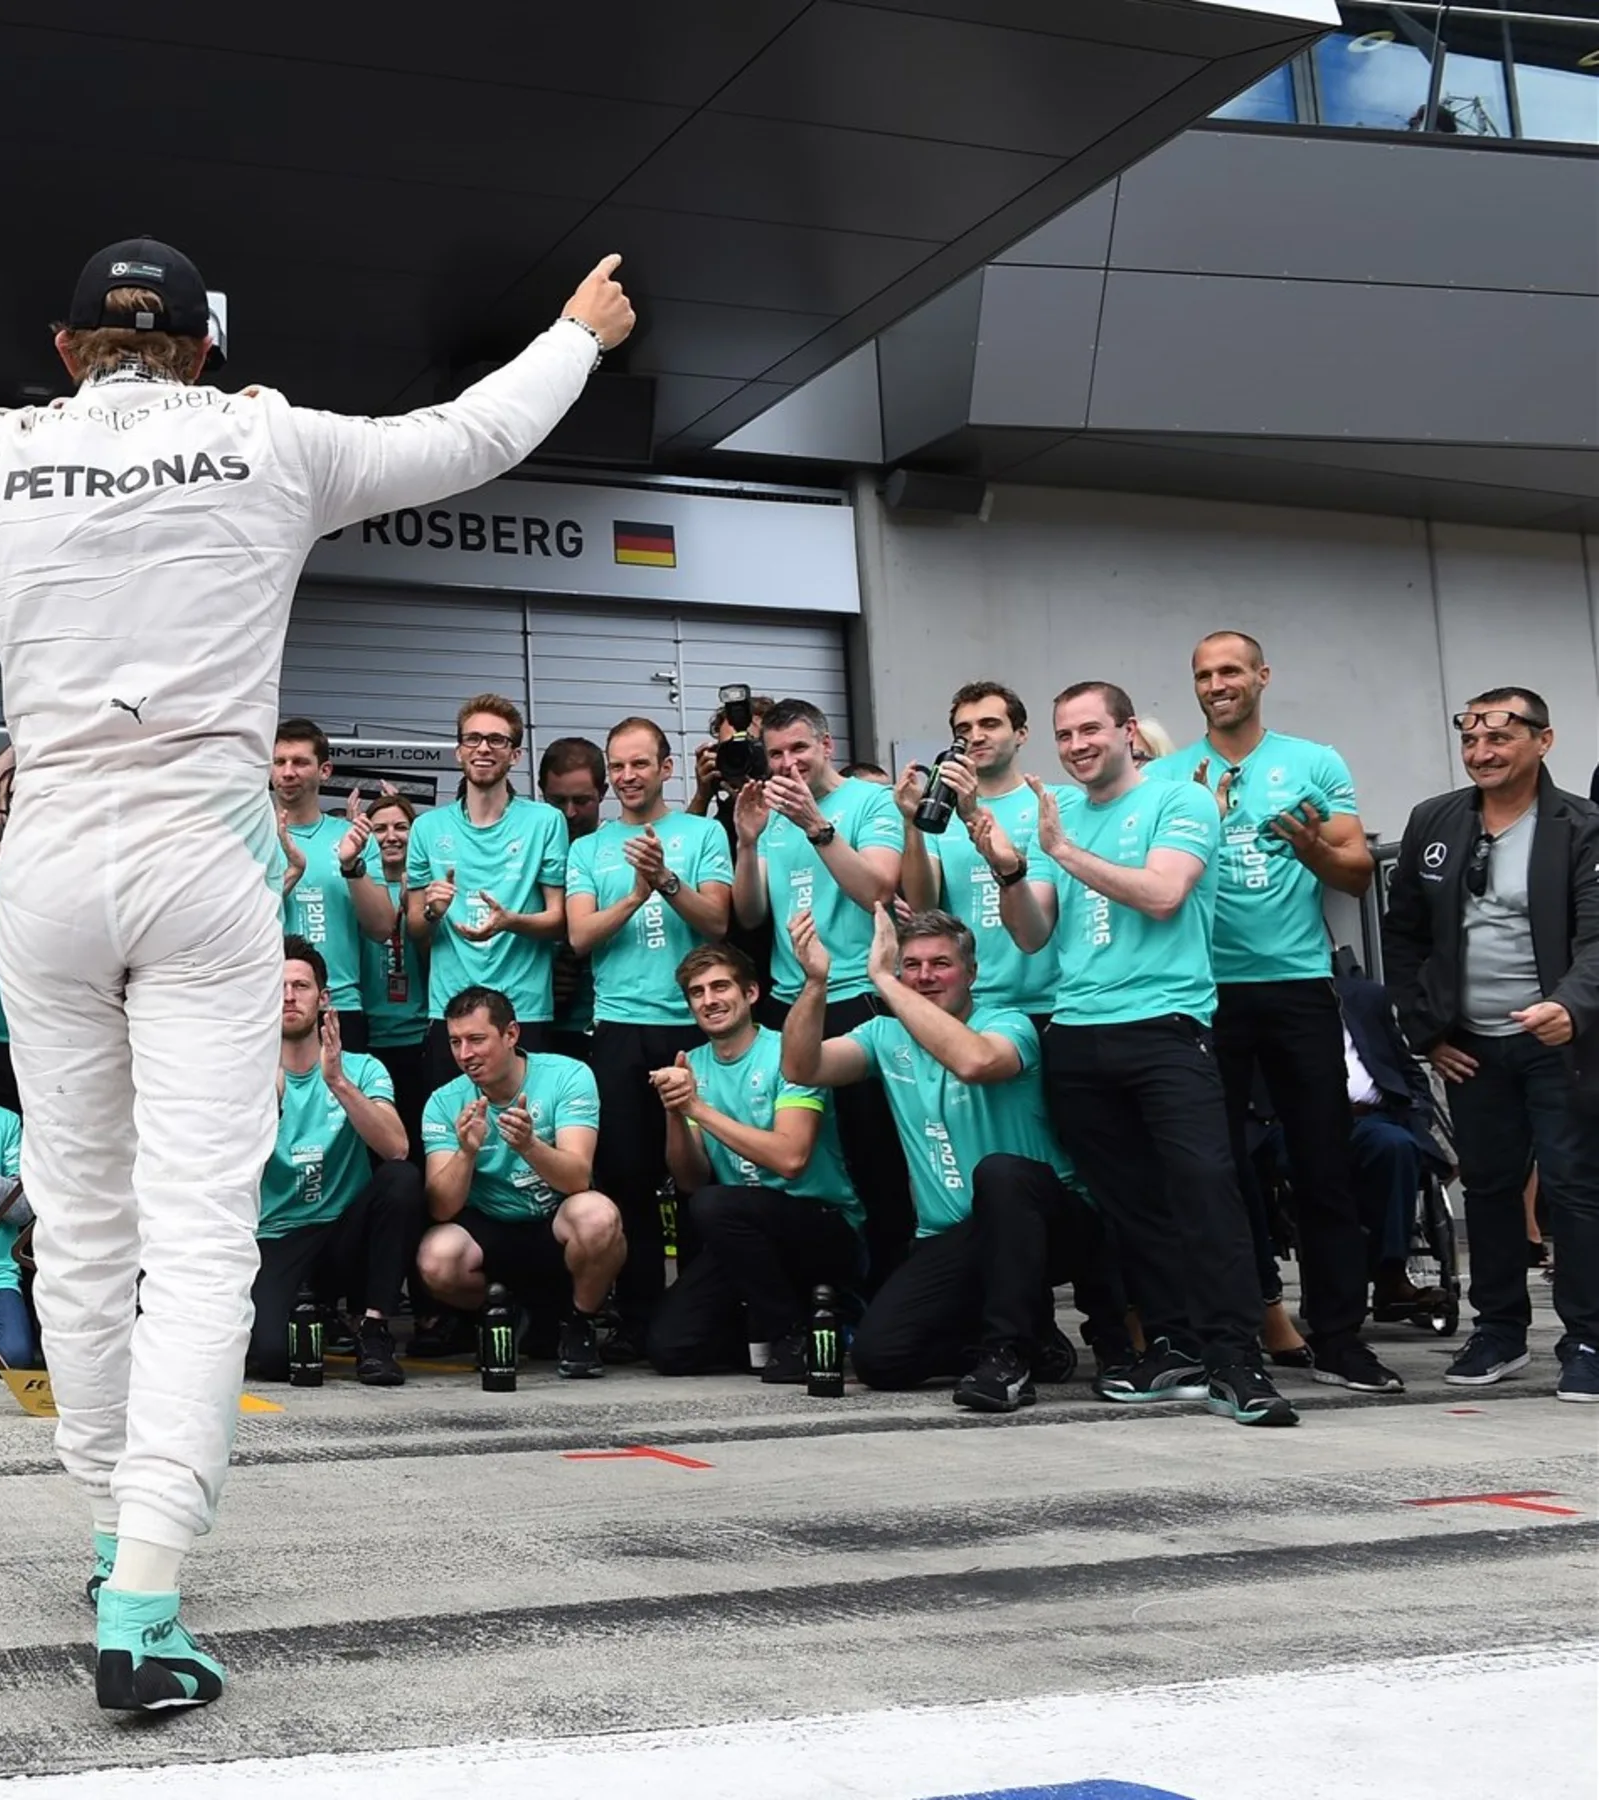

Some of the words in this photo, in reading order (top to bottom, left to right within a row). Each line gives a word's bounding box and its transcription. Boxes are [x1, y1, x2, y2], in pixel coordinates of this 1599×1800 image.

[3, 452, 251, 500] PETRONAS
[362, 507, 584, 558] ROSBERG
[306, 903, 326, 944] 2015
[644, 905, 666, 949] 2015
[303, 1163, 324, 1203] 2015
